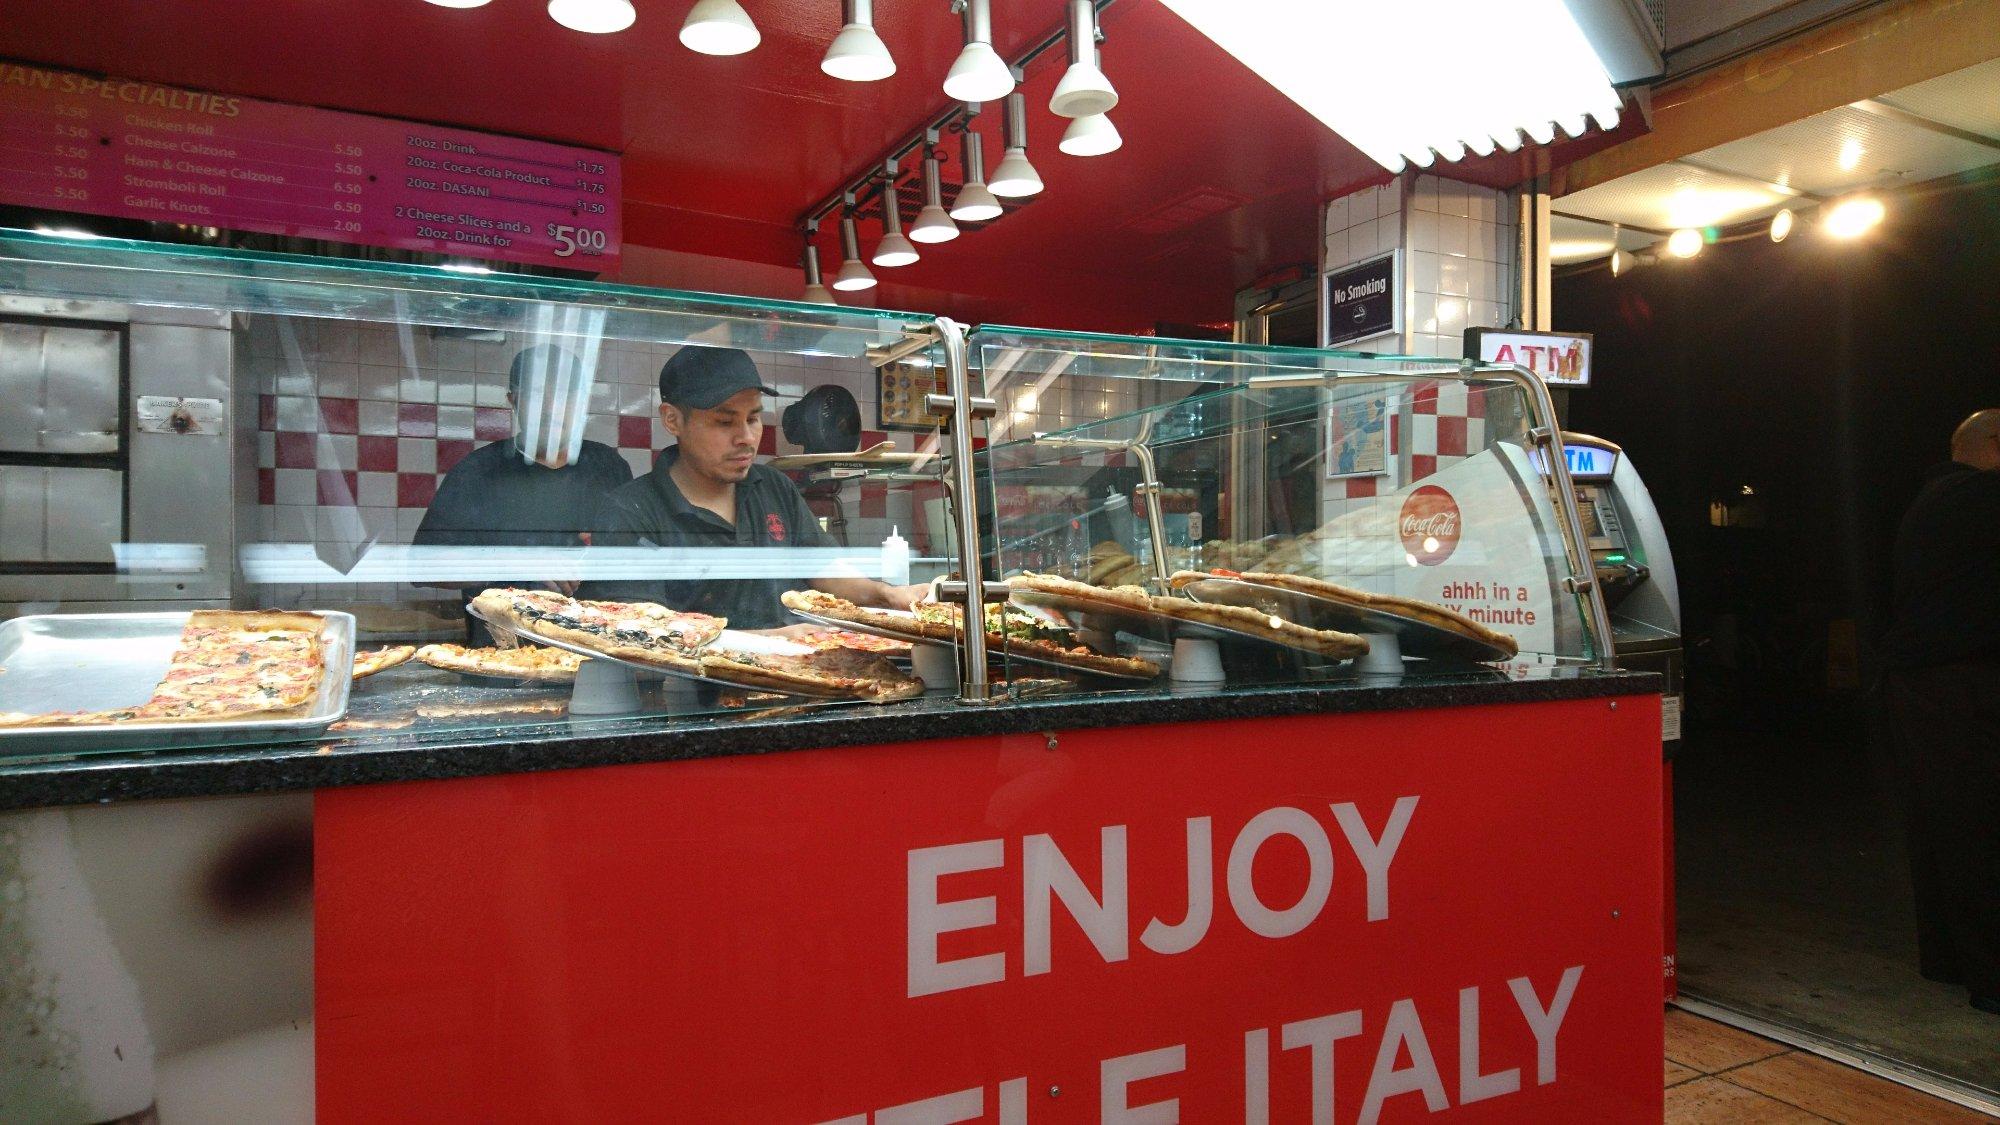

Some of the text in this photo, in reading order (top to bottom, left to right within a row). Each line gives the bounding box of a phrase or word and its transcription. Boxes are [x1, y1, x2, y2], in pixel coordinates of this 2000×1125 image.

[61, 73, 240, 117] SPECIALTIES
[56, 125, 88, 138] 5.50
[125, 114, 362, 157] Chicken Roll 5.50
[56, 146, 88, 158] 5.50
[125, 134, 362, 176] Cheese Calzone 5.50
[407, 136, 605, 175] 20oz. Drink $1.75
[55, 166, 88, 179] 5.50
[124, 154, 362, 194] Ham & Cheese Calzone 6.50
[407, 156, 605, 194] 20oz. Coca-Cola Product $1.75
[54, 187, 88, 200] 5.50
[124, 174, 361, 214] Stromboli Roll 6.50
[406, 178, 605, 214] 20oz. DASANI $1.50
[124, 195, 361, 232] Garlic Knots 2.00
[395, 206, 531, 234] 2 Cheese Slices and a
[416, 226, 452, 240] 20oz.
[455, 230, 491, 245] Drink
[493, 234, 512, 247] for
[1334, 289, 1346, 305] No
[1347, 278, 1386, 301] Smoking
[1494, 344, 1578, 373] ATM
[1564, 450, 1594, 472] TM
[1402, 512, 1457, 537] Coca-Cola
[1442, 581, 1528, 602] ahhh in a
[1468, 605, 1536, 626] minute
[907, 795, 1421, 999] ENJOY
[1244, 965, 1585, 1125] ITALY
